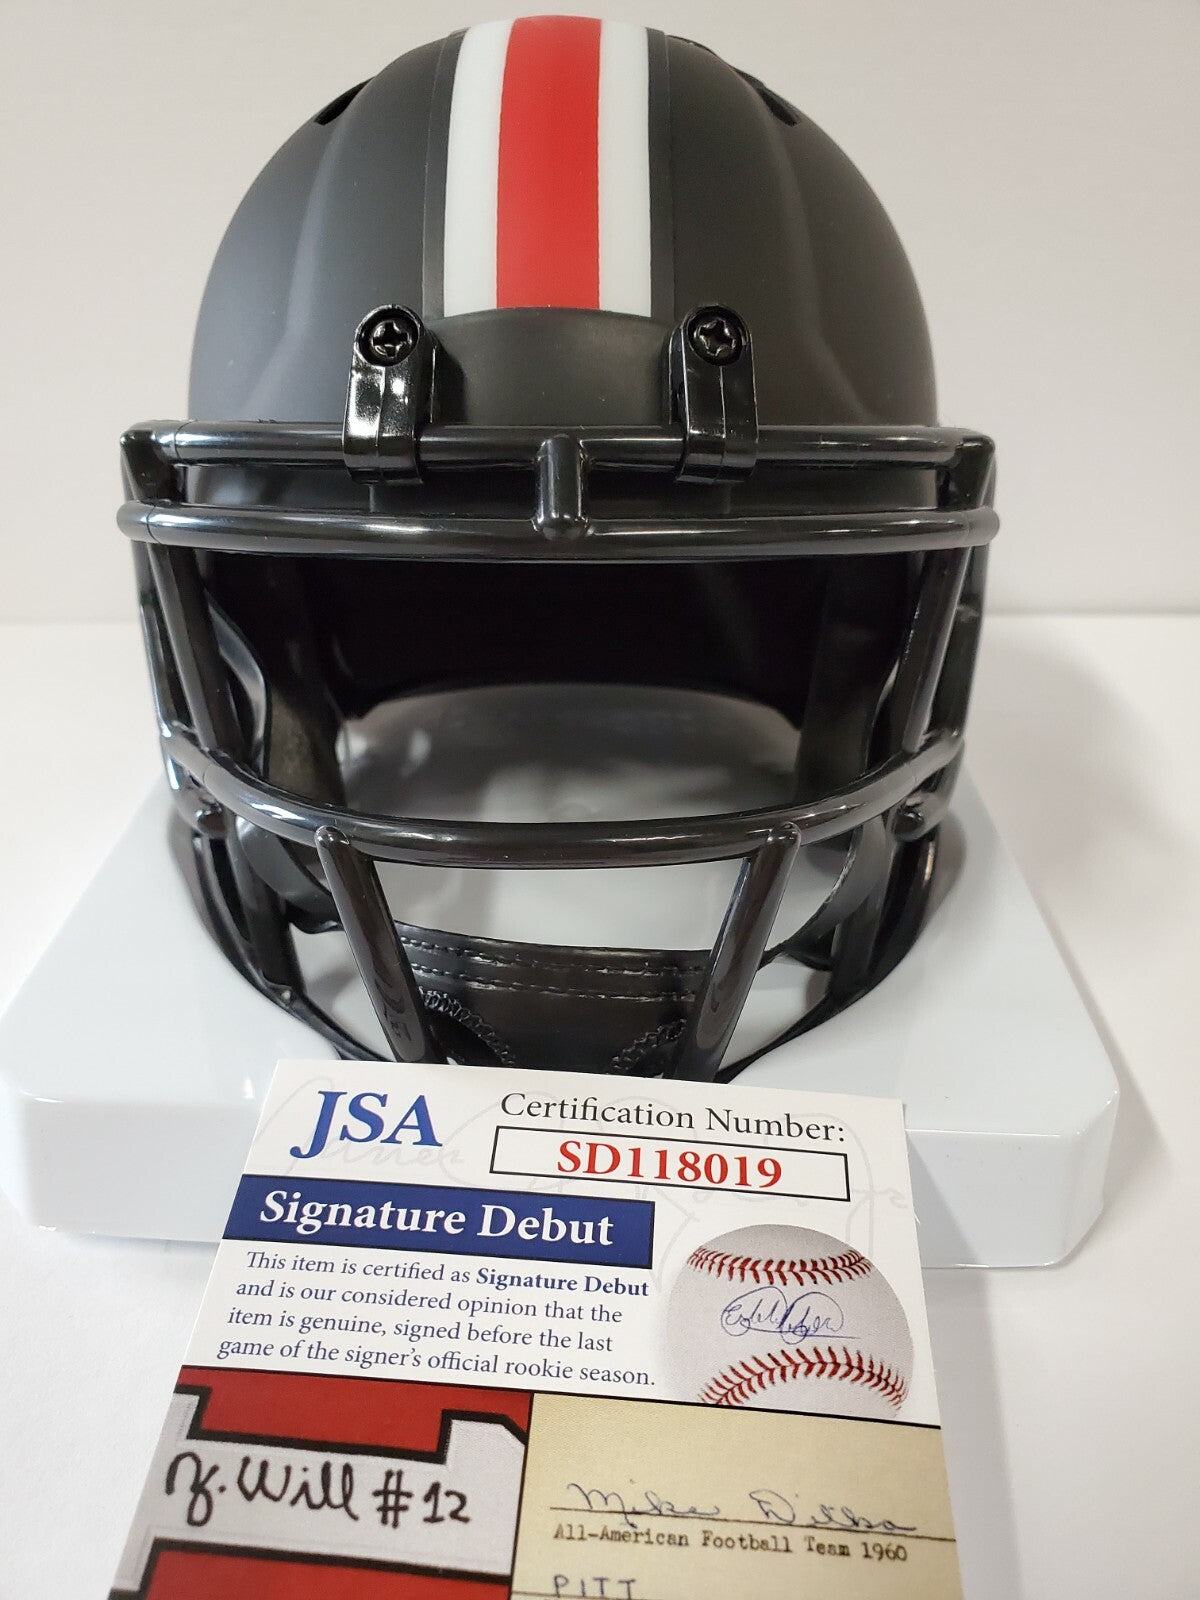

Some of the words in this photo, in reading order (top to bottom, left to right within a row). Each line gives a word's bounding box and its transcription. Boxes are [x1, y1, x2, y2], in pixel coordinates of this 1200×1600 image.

[290, 1091, 443, 1159] JSA
[500, 1092, 694, 1129] Certification
[705, 1107, 846, 1142] Number:
[556, 1140, 783, 1188] SD118019
[259, 1190, 467, 1235] Signature
[477, 1204, 615, 1247] Debut
[246, 1250, 286, 1271] This
[291, 1255, 335, 1275] item
[341, 1259, 358, 1276] is
[362, 1261, 445, 1280] certified
[450, 1270, 472, 1284] as
[476, 1267, 577, 1291] Signature
[584, 1276, 650, 1298] Debut
[235, 1279, 275, 1298] and
[278, 1283, 296, 1300] is
[300, 1288, 337, 1302] our
[341, 1288, 451, 1310] considered
[457, 1297, 537, 1317] opinion
[545, 1300, 586, 1320] that
[590, 1304, 623, 1324] the
[227, 1306, 273, 1327] item
[279, 1312, 295, 1329] is
[299, 1315, 387, 1336] genuine,
[393, 1322, 461, 1342] signed
[467, 1325, 533, 1345] before
[538, 1329, 575, 1350] the
[578, 1331, 613, 1353] last
[217, 1341, 274, 1360] game
[279, 1339, 304, 1359] of
[306, 1342, 340, 1362] the
[345, 1347, 421, 1368] signer's
[427, 1351, 499, 1373] official
[504, 1358, 573, 1378] rookie
[579, 1368, 656, 1386] season.
[553, 1523, 690, 1548] All-American
[701, 1529, 793, 1555] Football
[803, 1535, 852, 1558] Team
[861, 1540, 909, 1563] 1960
[553, 1573, 636, 1599] PITT
